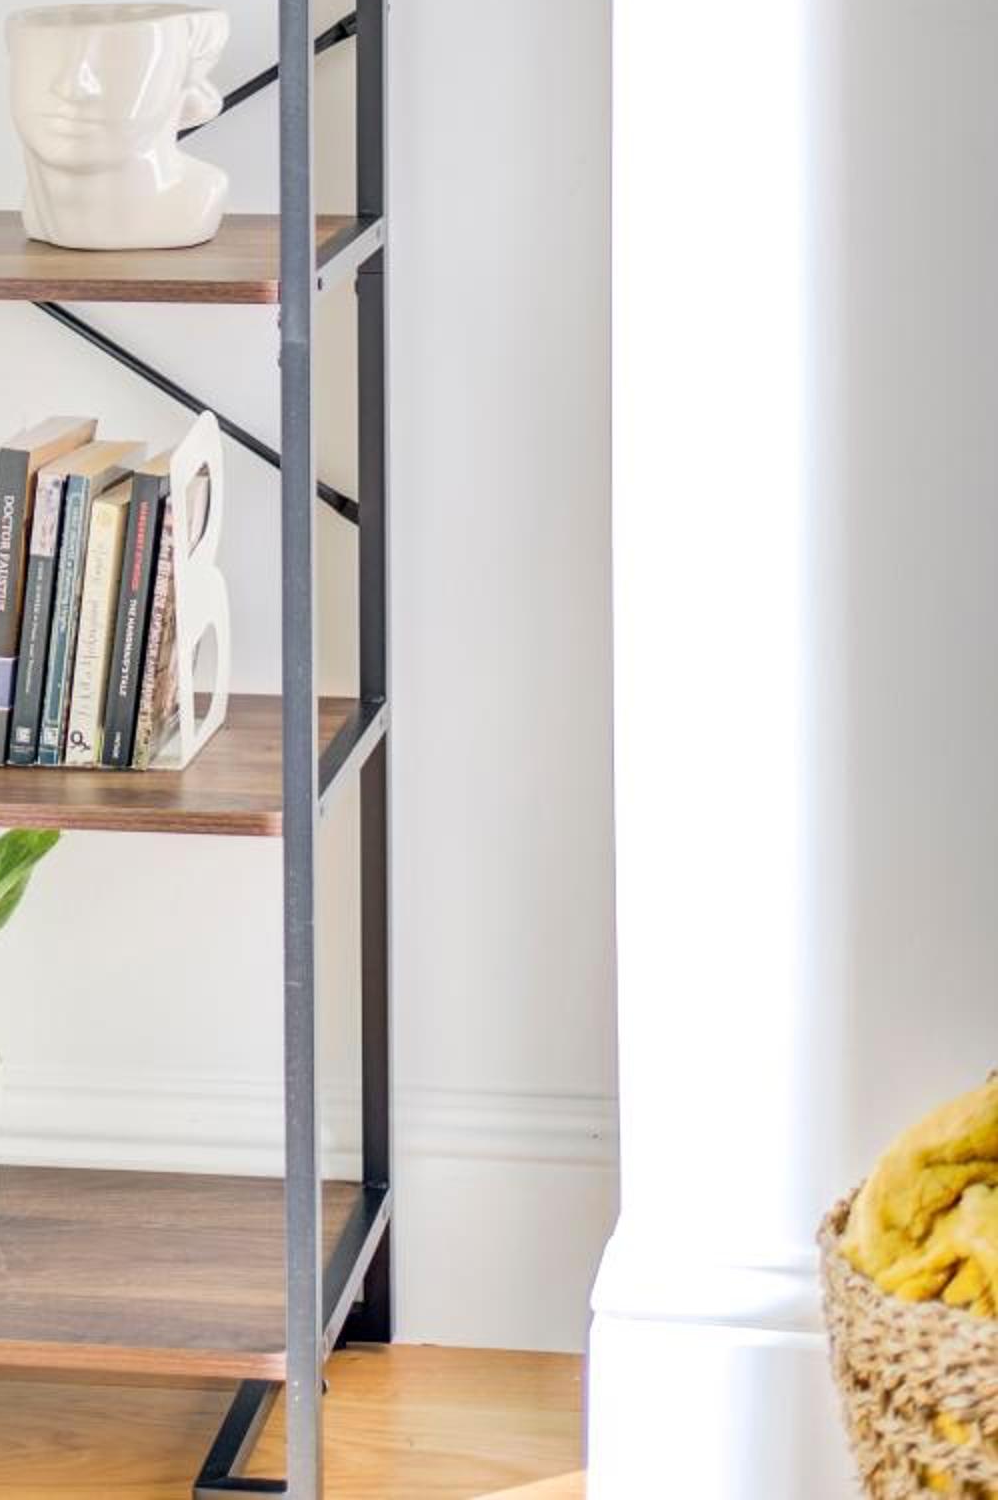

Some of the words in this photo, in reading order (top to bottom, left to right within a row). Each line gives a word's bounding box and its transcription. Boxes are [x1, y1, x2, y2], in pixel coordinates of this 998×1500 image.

[0, 495, 15, 550] DOCTOR
[126, 598, 138, 615] THE
[117, 675, 129, 697] TALE
